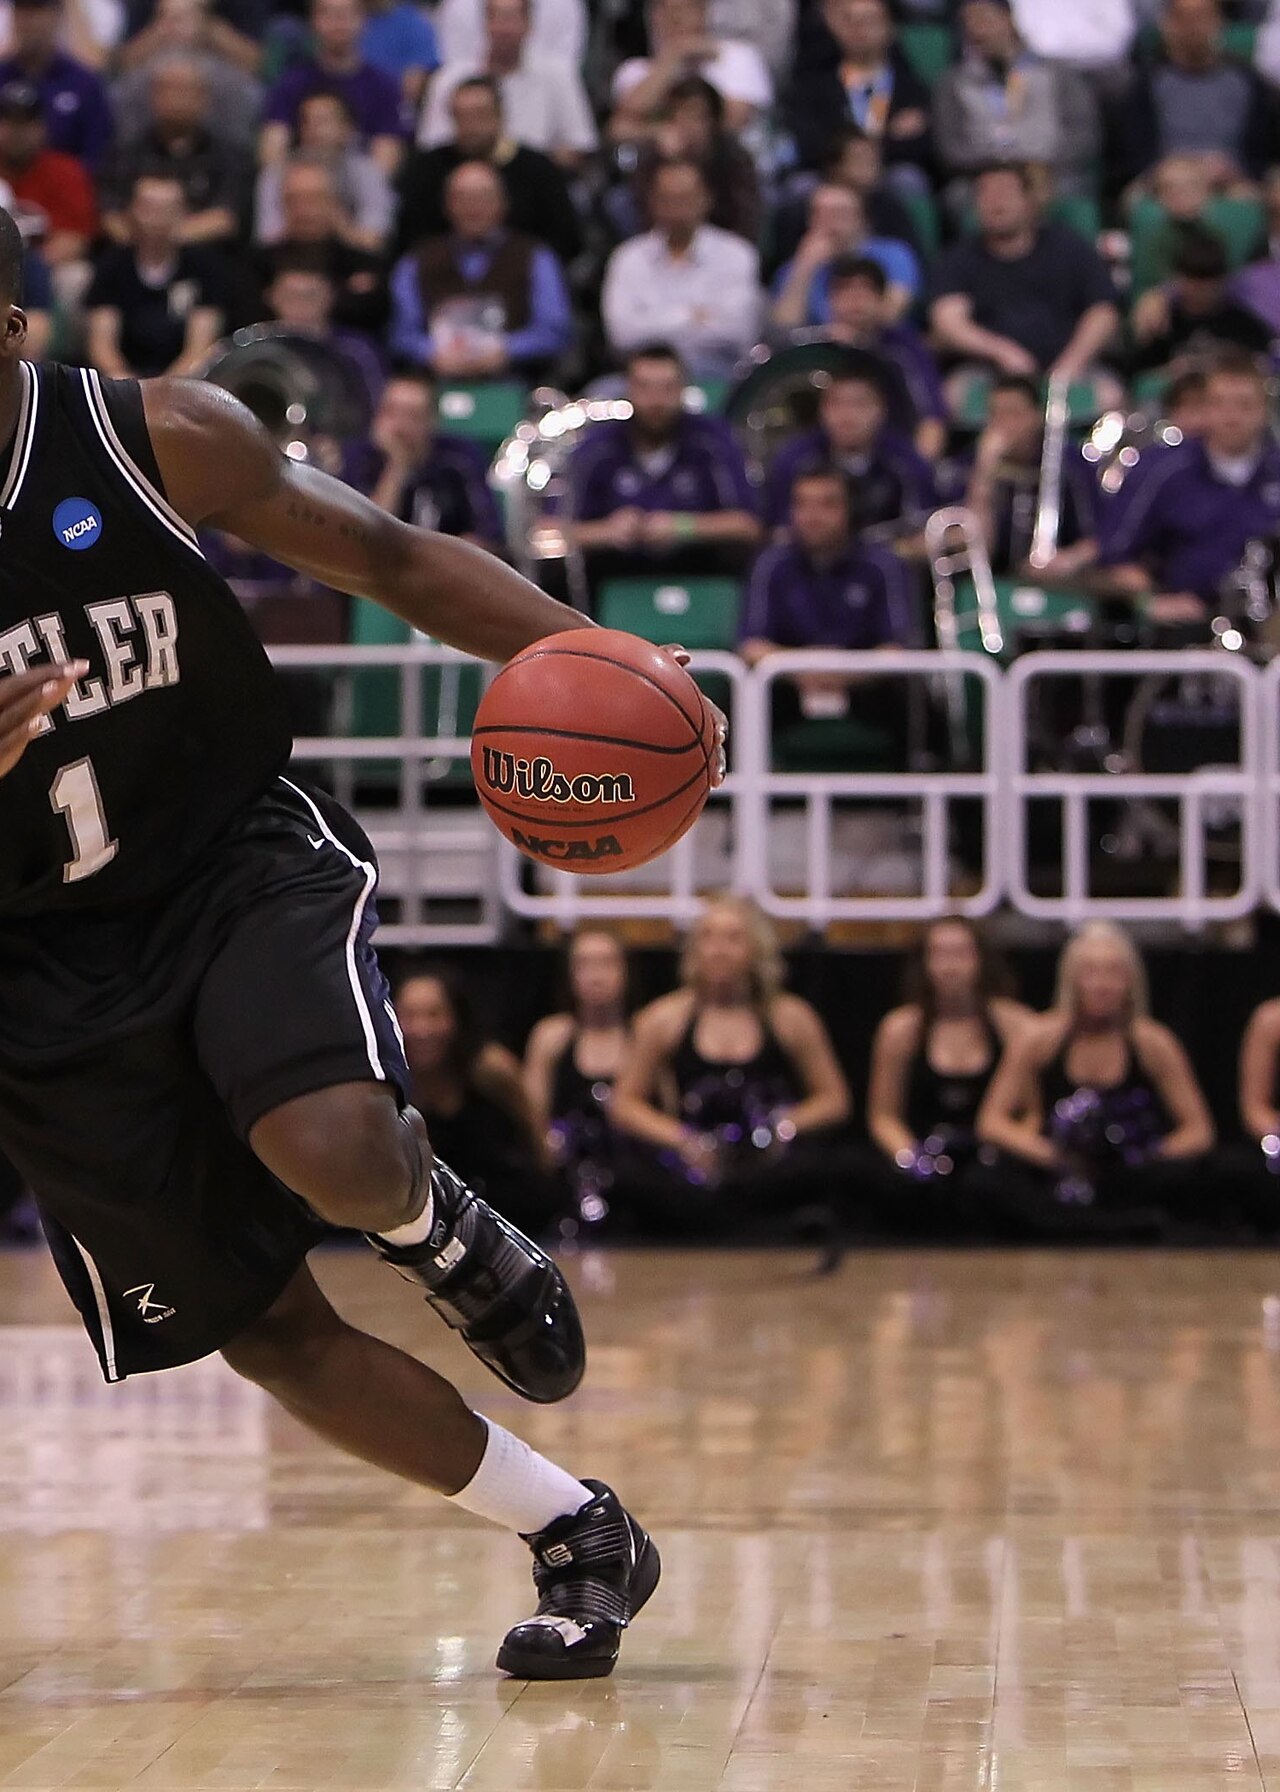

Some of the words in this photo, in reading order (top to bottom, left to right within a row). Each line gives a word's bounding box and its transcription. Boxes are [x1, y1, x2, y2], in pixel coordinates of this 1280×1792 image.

[62, 515, 98, 543] NCAA
[482, 745, 636, 805] Wilson
[48, 755, 120, 884] 1
[510, 826, 624, 861] NCAA
